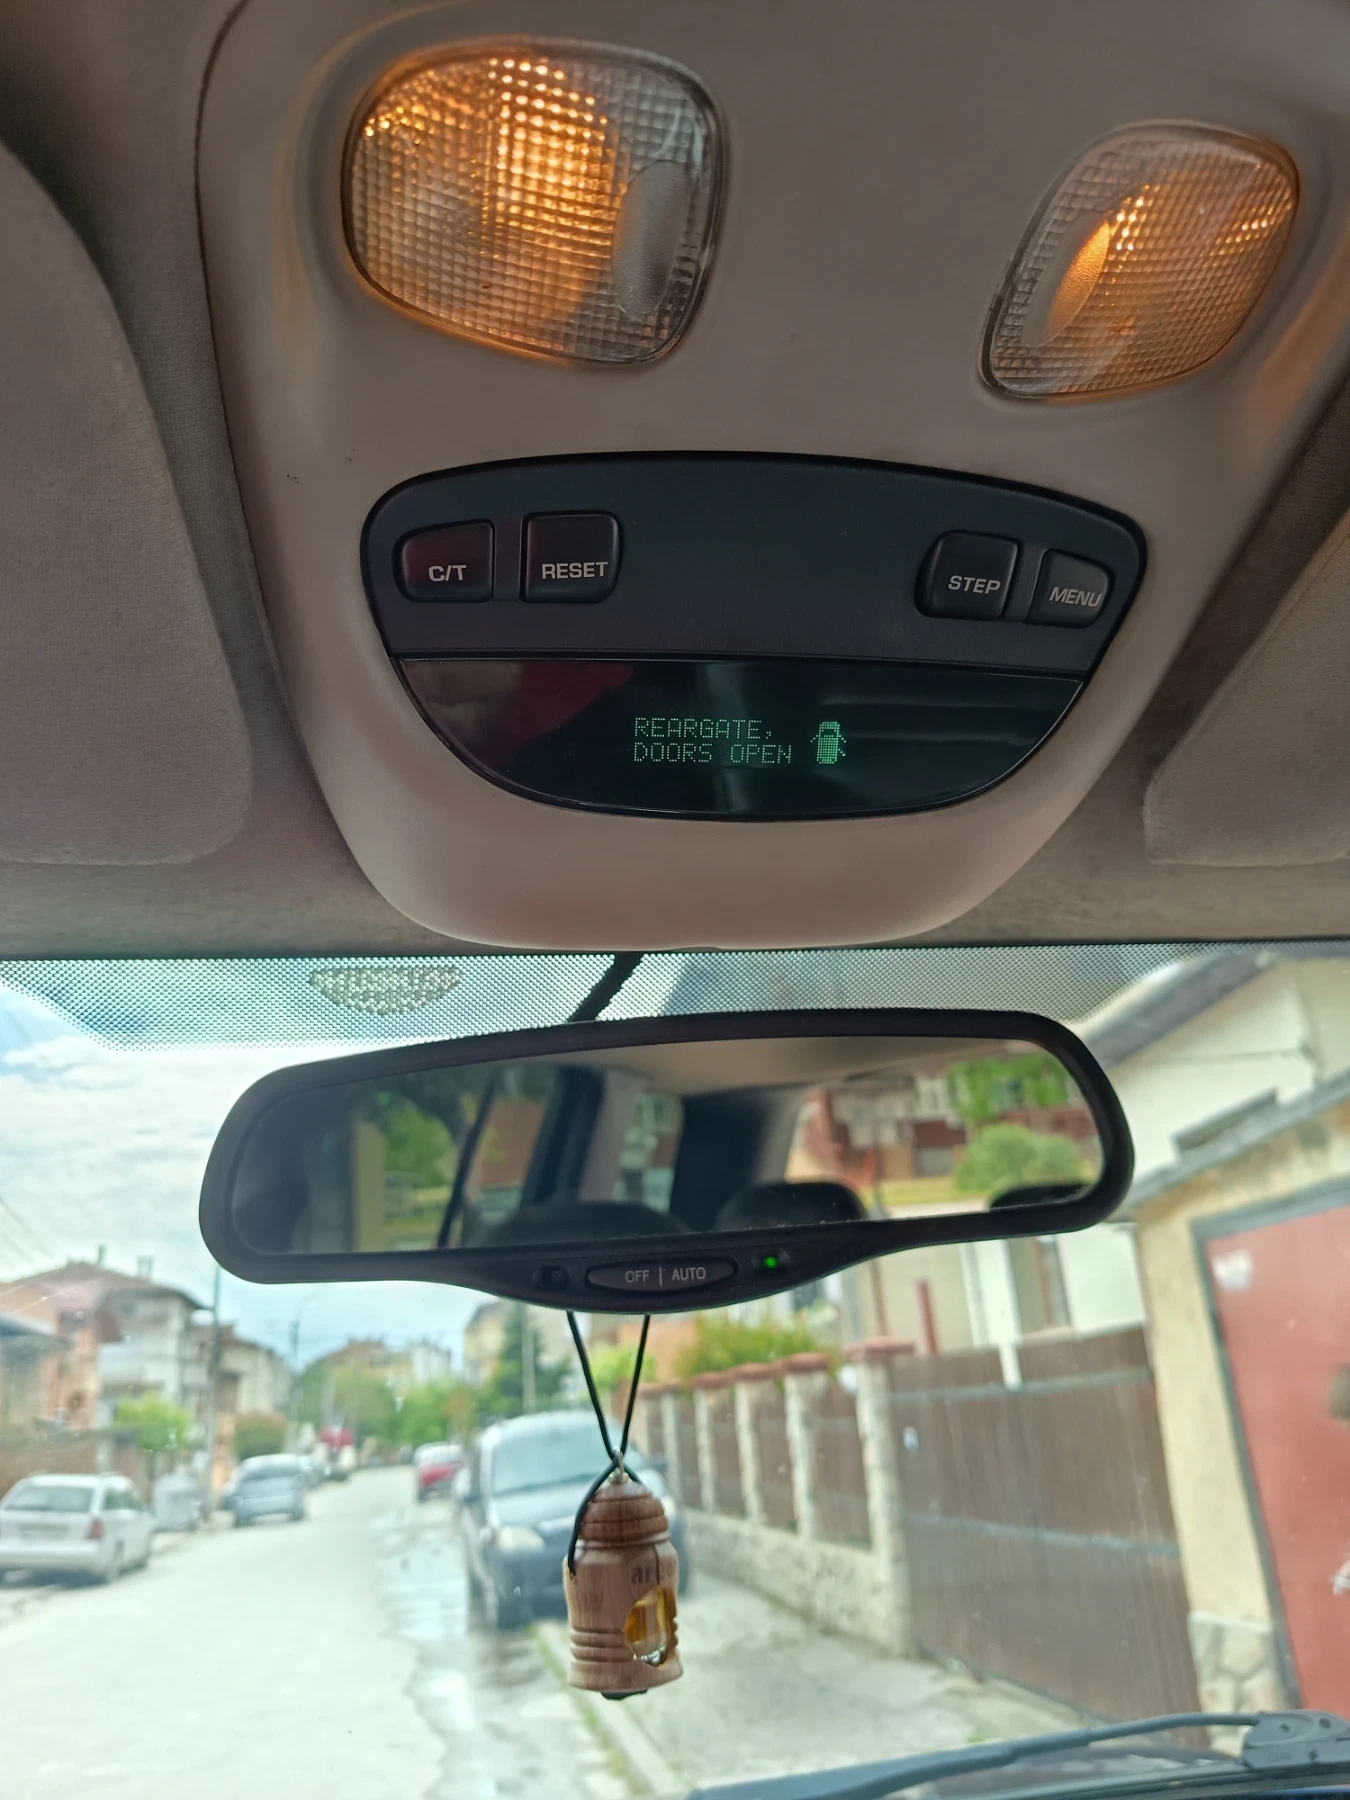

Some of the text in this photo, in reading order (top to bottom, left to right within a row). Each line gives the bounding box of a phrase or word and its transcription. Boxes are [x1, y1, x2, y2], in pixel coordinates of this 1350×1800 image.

[428, 564, 467, 582] C/T
[541, 562, 609, 580] RESET
[948, 575, 1001, 595] STEP
[1049, 586, 1103, 608] MENU
[634, 717, 771, 739] REARGATE,
[633, 742, 792, 764] DOORS OPEN
[625, 1267, 707, 1283] OFF AUTO
